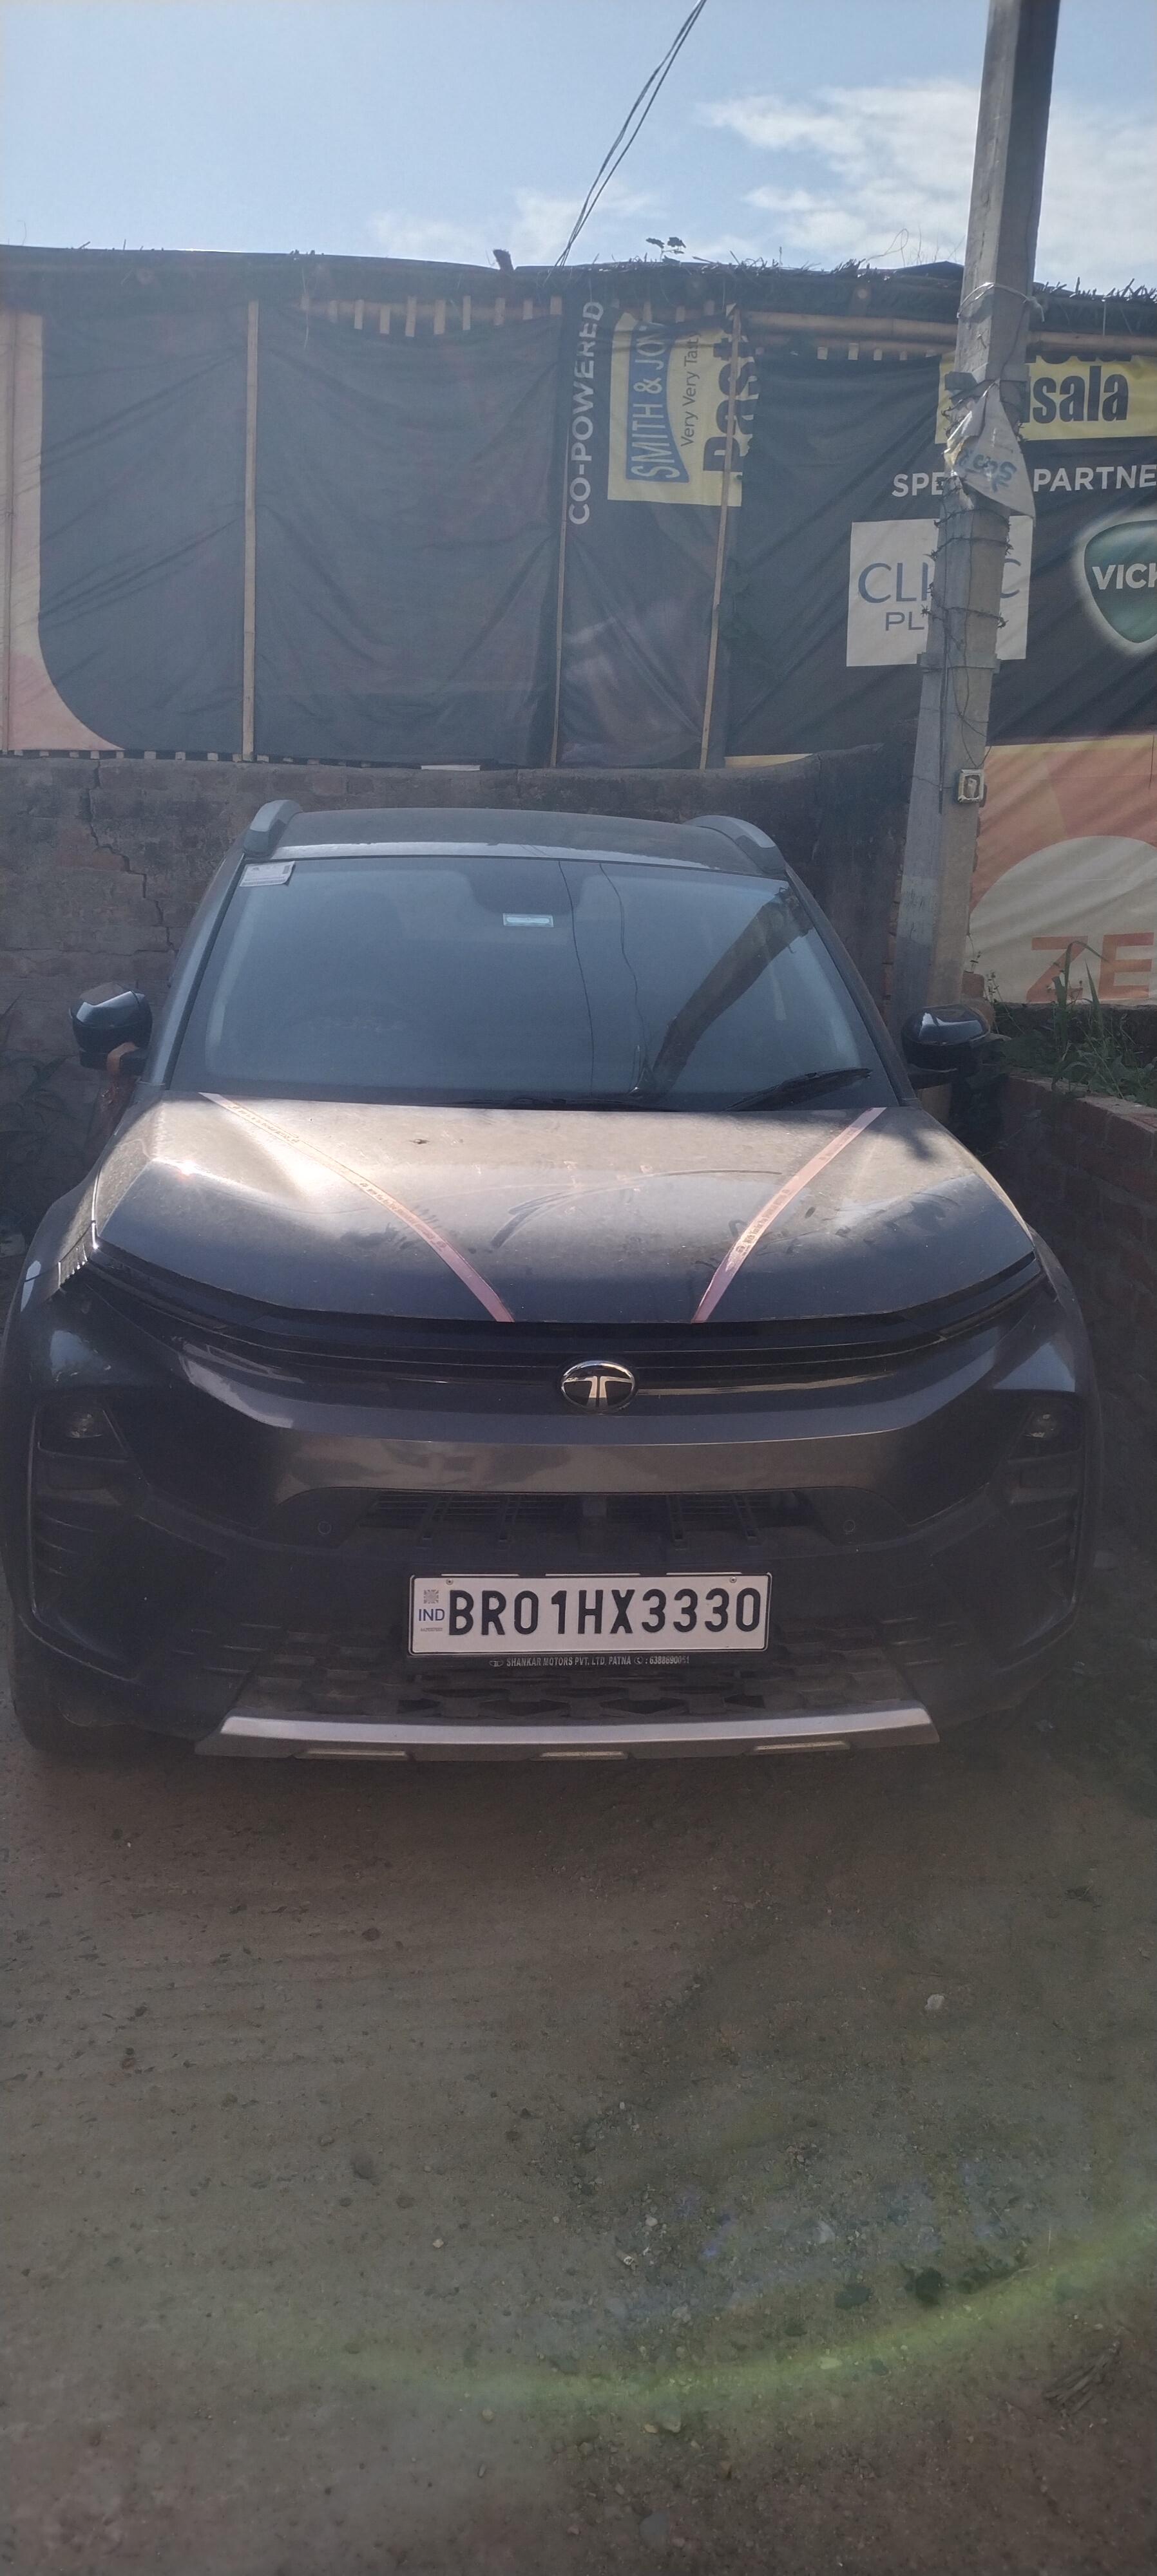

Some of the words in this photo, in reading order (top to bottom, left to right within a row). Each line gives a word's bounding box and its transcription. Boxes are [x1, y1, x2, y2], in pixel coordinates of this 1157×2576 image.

[633, 377, 662, 394] &
[682, 371, 700, 407] Very
[1020, 365, 1129, 424] sala
[569, 301, 604, 524] CO-POWERED
[680, 411, 698, 447] Very
[631, 404, 680, 478] SMITH
[885, 612, 925, 631] PL
[419, 1609, 445, 1621] IND
[449, 1588, 761, 1635] BR01HX3330
[506, 1658, 541, 1667] SHANKAR
[542, 1657, 573, 1667] MOTORS
[608, 1656, 631, 1665] PATNA
